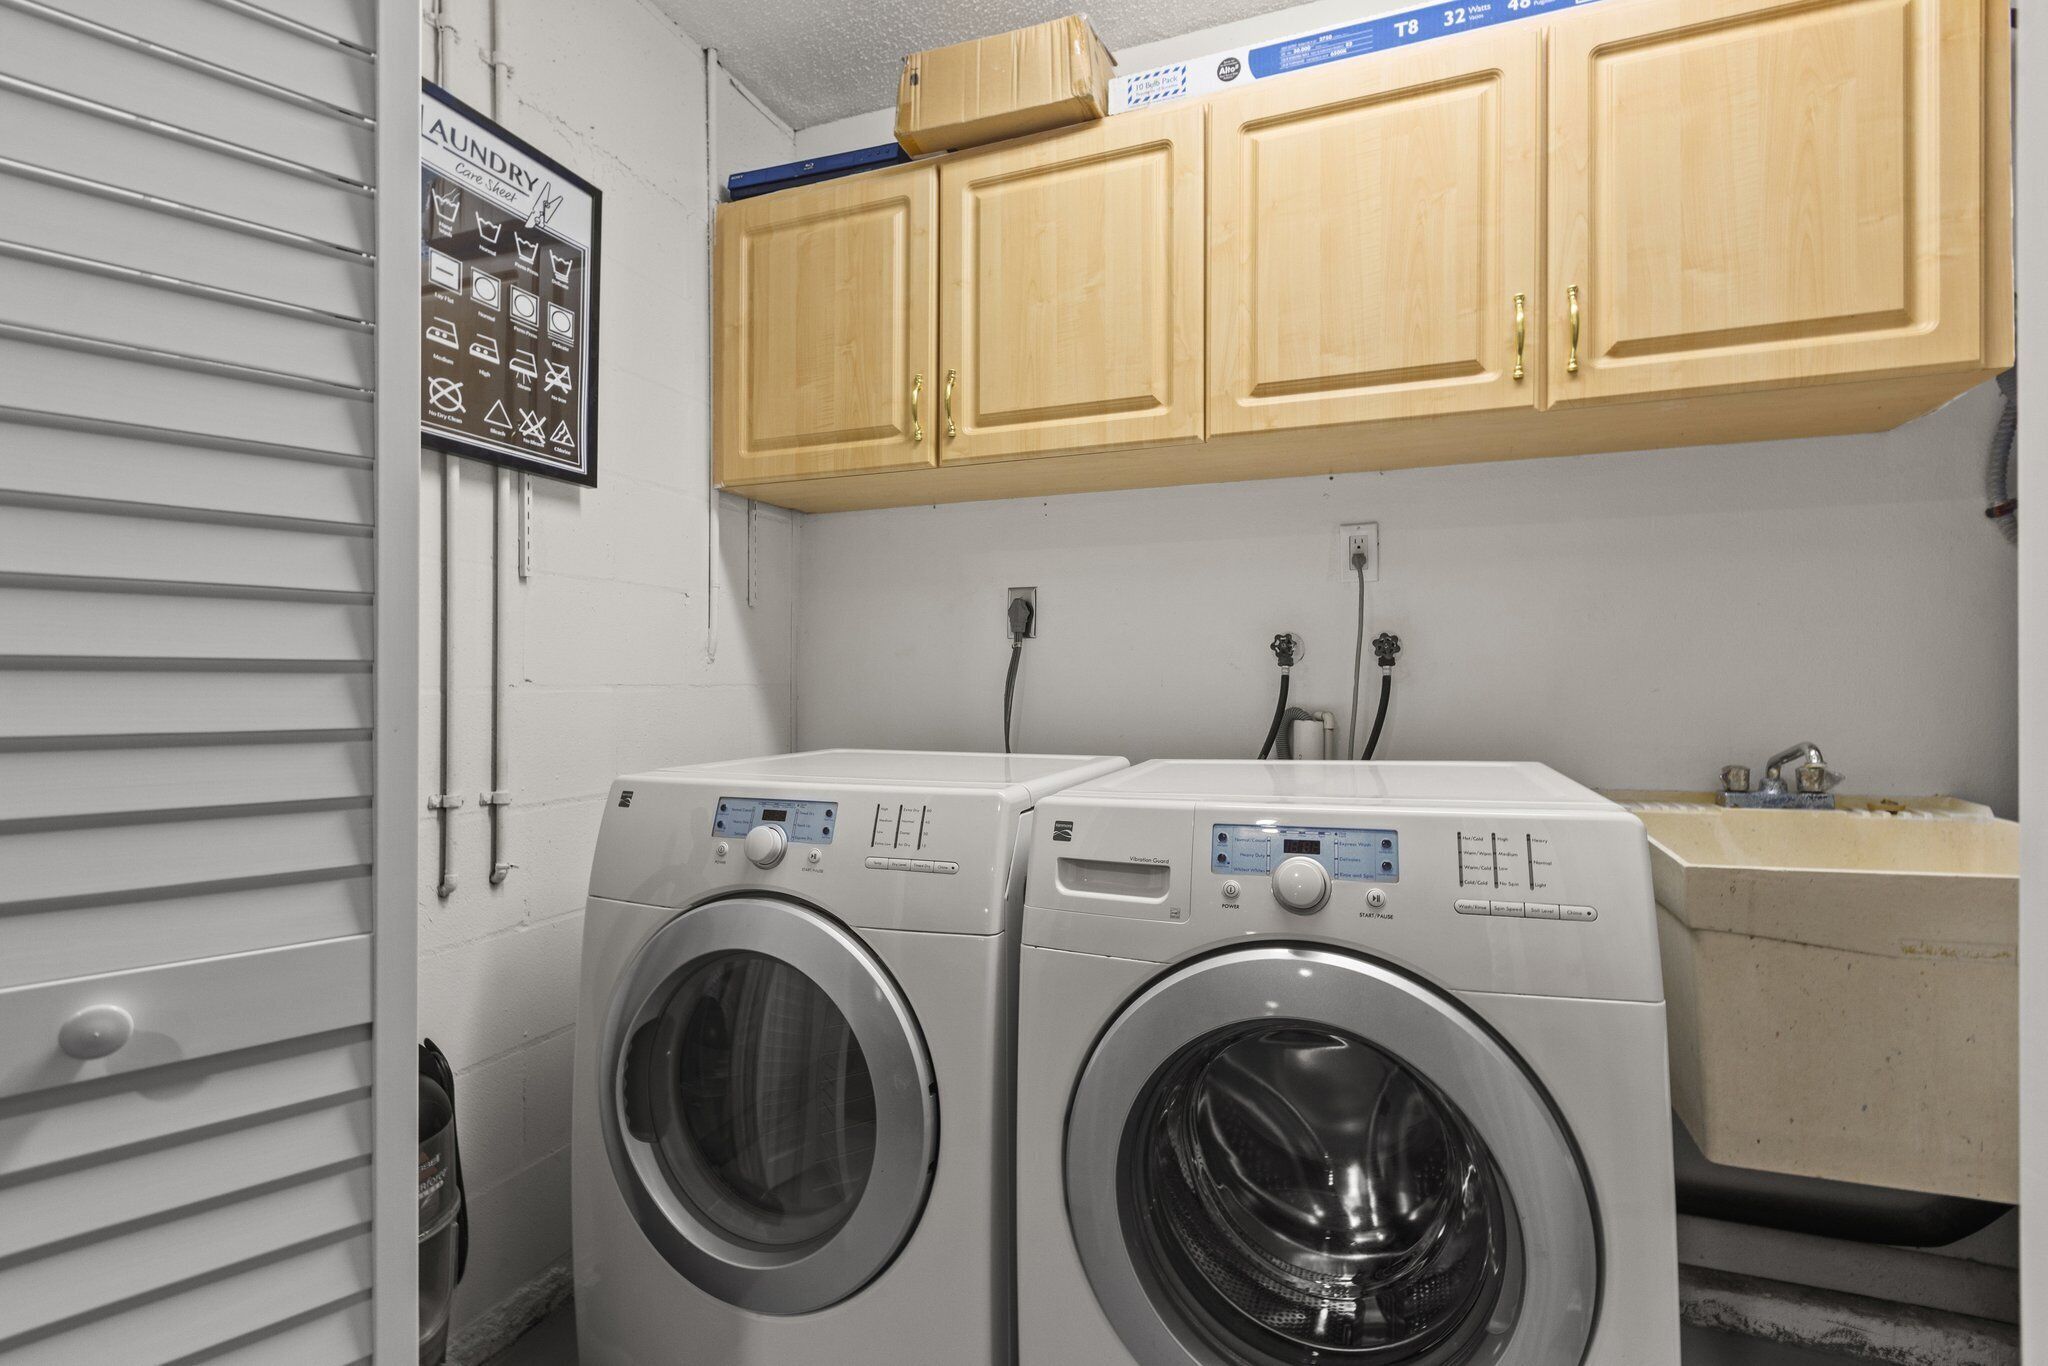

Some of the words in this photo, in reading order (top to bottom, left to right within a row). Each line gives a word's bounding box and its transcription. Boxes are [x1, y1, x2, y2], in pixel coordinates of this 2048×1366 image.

[1444, 8, 1466, 26] 32
[1468, 3, 1491, 14] Watts
[1394, 19, 1418, 37] T8
[1145, 80, 1160, 89] Bulb
[1162, 76, 1178, 85] Pack
[455, 162, 482, 185] Care
[485, 179, 517, 203] Sheet
[433, 353, 454, 365] Medium
[479, 369, 491, 378] High
[437, 412, 447, 420] Dry
[447, 414, 463, 424] Clean
[554, 446, 571, 456] Chlorine
